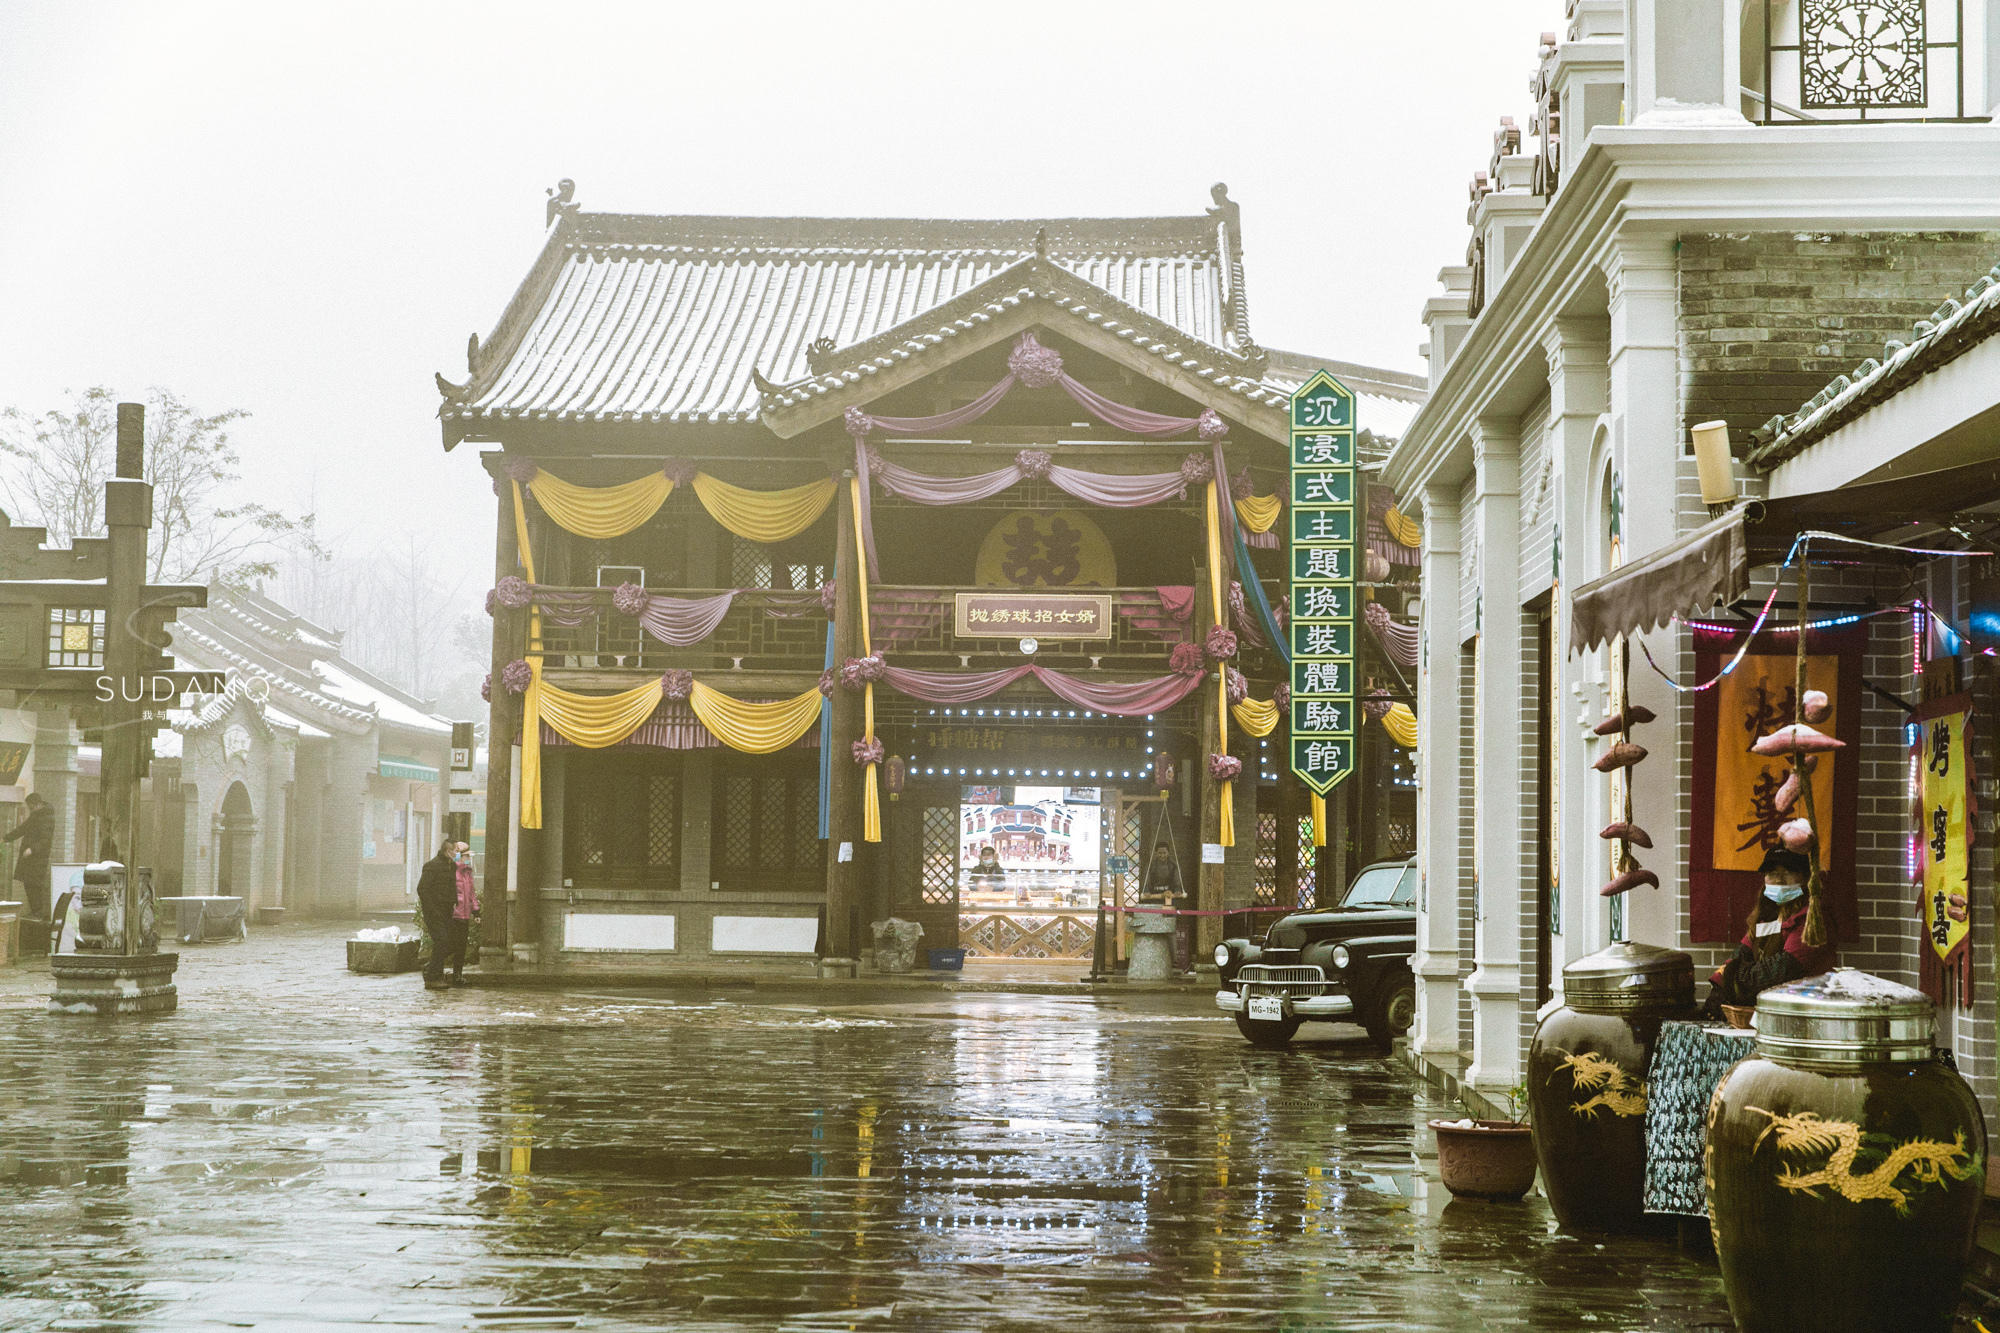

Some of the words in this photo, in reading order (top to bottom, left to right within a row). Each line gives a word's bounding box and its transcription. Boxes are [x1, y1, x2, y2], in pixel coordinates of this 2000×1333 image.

[1304, 396, 1342, 773] 沉浸式主題換裝體驗館
